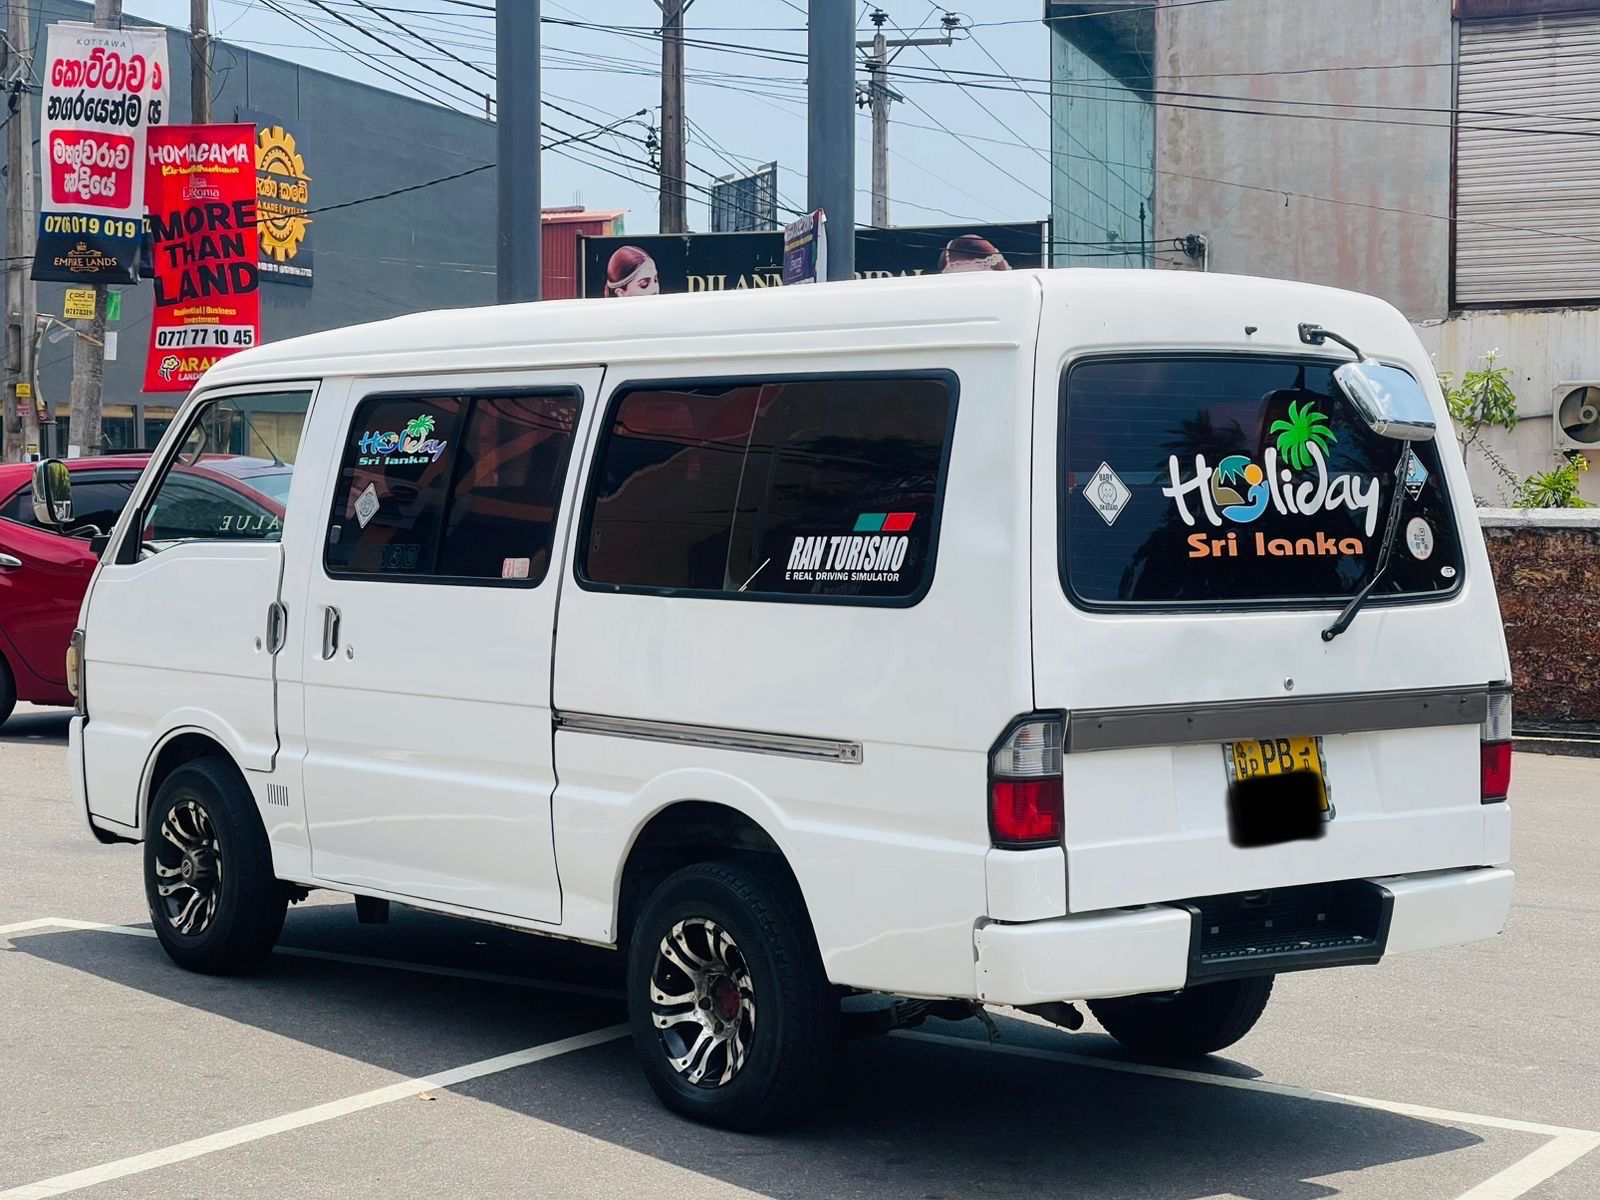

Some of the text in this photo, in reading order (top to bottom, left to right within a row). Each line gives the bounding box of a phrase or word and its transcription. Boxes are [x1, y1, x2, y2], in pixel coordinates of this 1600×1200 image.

[77, 39, 126, 48] KOTTAWA
[52, 47, 146, 93] කොට්ටාව
[148, 143, 250, 165] HOMAGAMA
[104, 220, 136, 238] 019
[149, 200, 257, 243] MORE
[86, 258, 117, 267] LANDS
[163, 233, 246, 268] THAN
[154, 262, 259, 307] LAND
[206, 305, 237, 315] Business
[191, 329, 208, 344] 77
[213, 329, 229, 345] 10
[233, 330, 252, 345] 45
[358, 428, 448, 463] Holiday
[359, 455, 429, 465] Sri lanka
[1162, 440, 1380, 538] Holiday
[787, 535, 909, 571] RAN TURISMO
[1187, 531, 1364, 558] Sri lanka
[793, 571, 813, 580] REAL
[815, 571, 849, 581] DRIVING
[851, 572, 900, 582] SIMULATOR
[1259, 738, 1295, 774] PB
